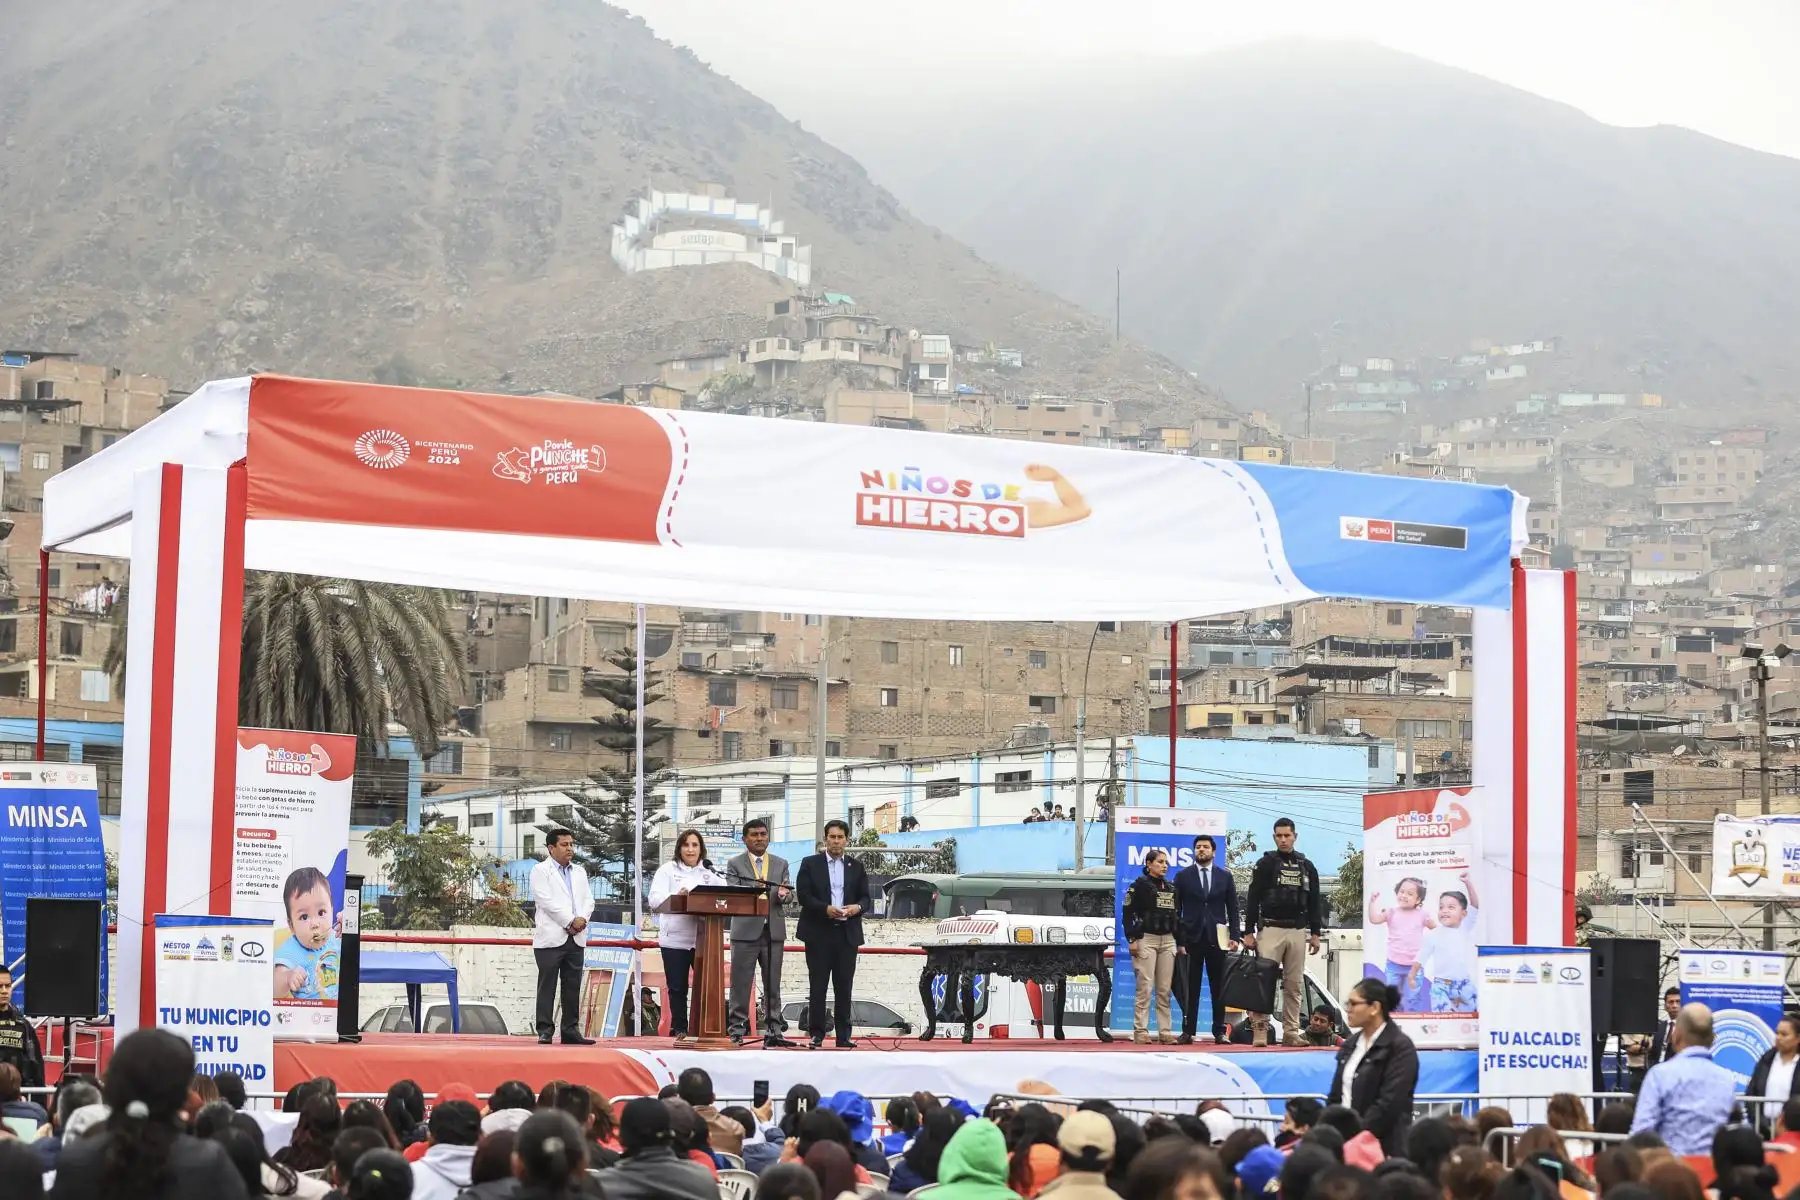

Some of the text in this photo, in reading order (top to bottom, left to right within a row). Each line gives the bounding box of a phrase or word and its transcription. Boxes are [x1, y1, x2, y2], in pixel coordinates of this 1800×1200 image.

[415, 440, 474, 450] BICENTENARIO
[544, 439, 573, 450] Ponle
[431, 447, 457, 456] PERÚ
[530, 446, 588, 467] PUNCHE
[427, 455, 460, 465] 2024
[546, 470, 578, 484] PERÚ
[860, 466, 1021, 501] NIÑOS DE
[862, 496, 1020, 533] HIERRO
[1369, 526, 1390, 535] PERÚ
[267, 748, 298, 761] NIÑOS
[267, 761, 311, 774] HIERRO
[258, 787, 306, 796] suplementación
[8, 805, 88, 828] MINSA
[1397, 811, 1433, 824] NIÑOS
[242, 830, 271, 838] Recuerda
[1398, 824, 1450, 838] HIERRO
[1128, 845, 1193, 868] MNS
[163, 942, 190, 950] NESTOR
[160, 1007, 181, 1024] TU
[186, 1008, 271, 1027] MUNICIPIO
[191, 1035, 239, 1053] EN TU
[1490, 1031, 1581, 1046] TU ALCALDE
[1484, 1054, 1588, 1072] ¡TE ESCUCHA!
